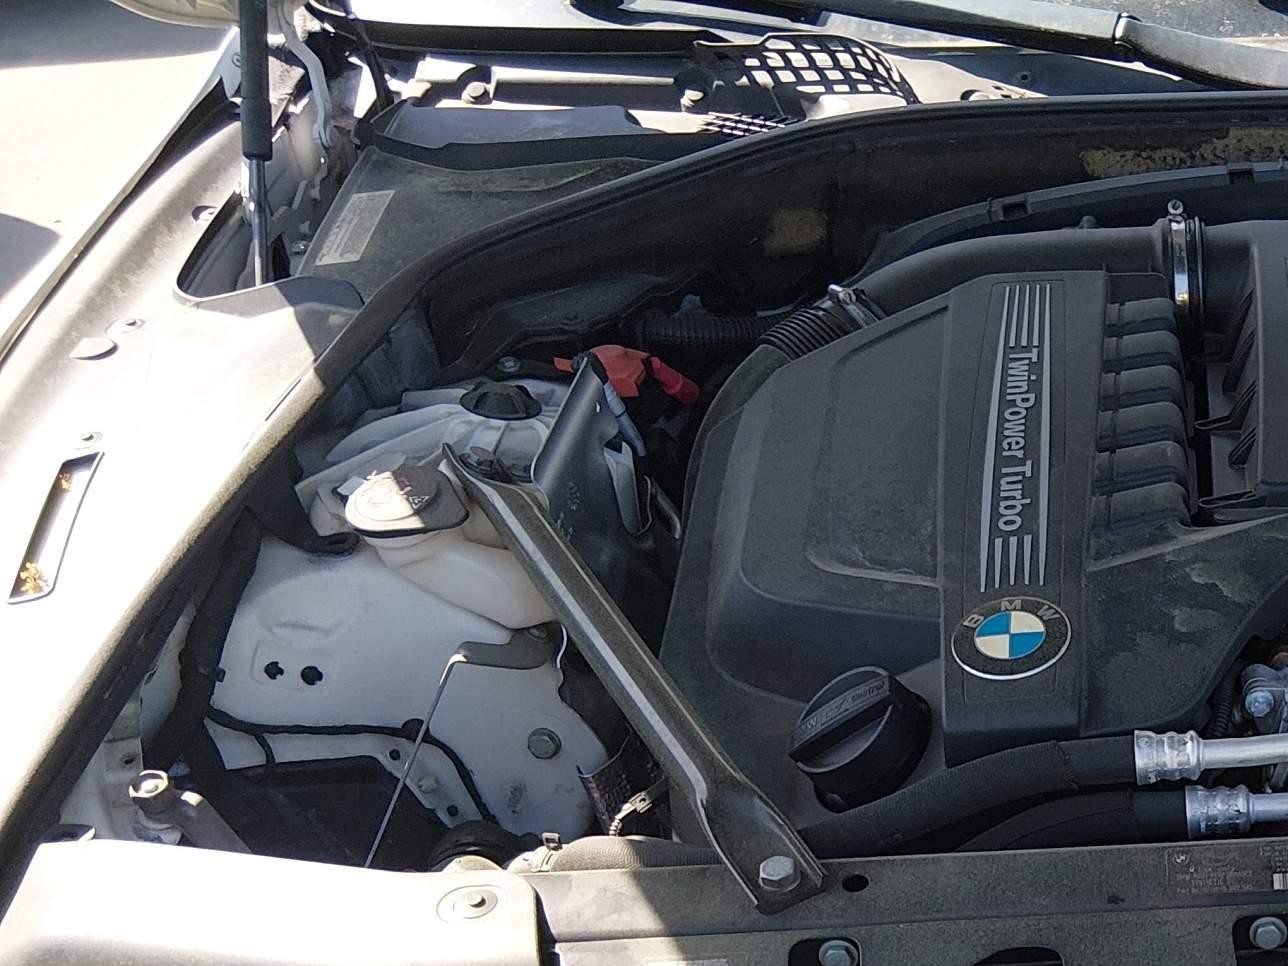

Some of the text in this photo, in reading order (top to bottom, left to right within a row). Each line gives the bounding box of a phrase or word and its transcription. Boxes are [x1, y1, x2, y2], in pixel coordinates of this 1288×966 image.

[998, 347, 1038, 531] TwinPower Turbo
[963, 599, 1060, 628] BMW
